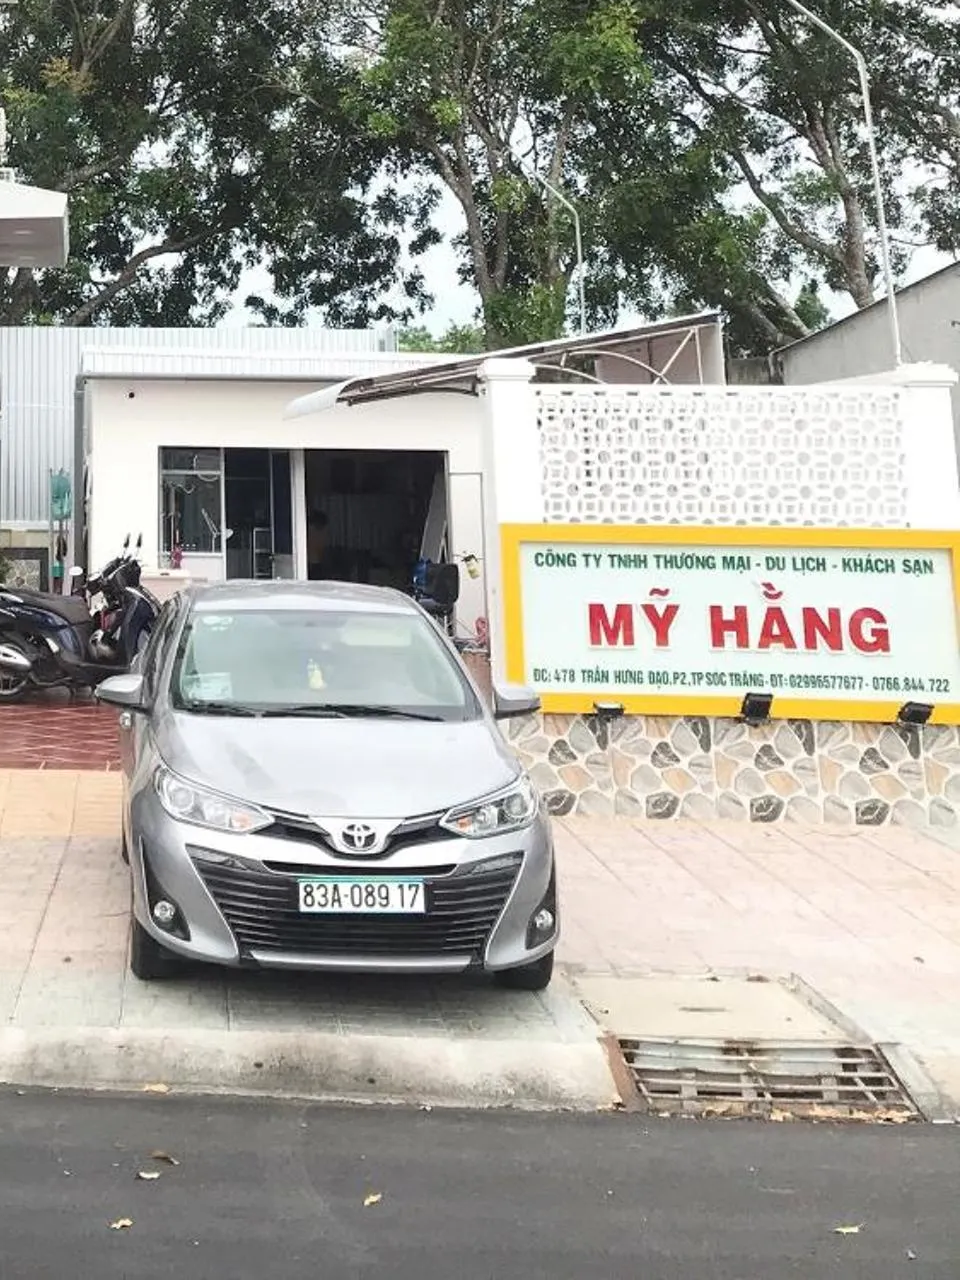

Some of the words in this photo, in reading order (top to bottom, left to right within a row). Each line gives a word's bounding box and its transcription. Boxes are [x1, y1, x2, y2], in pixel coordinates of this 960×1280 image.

[534, 549, 577, 567] CÔNG
[582, 553, 602, 568] TY
[608, 554, 648, 569] TNHH
[653, 552, 716, 569] THƯƠNG
[722, 556, 751, 574] MẠI
[765, 556, 786, 571] DU
[792, 557, 827, 576] LỊCH
[842, 554, 896, 574] KHÁCH
[902, 559, 934, 577] SẠN
[588, 587, 680, 648] MỸ
[709, 582, 891, 653] HẰNG
